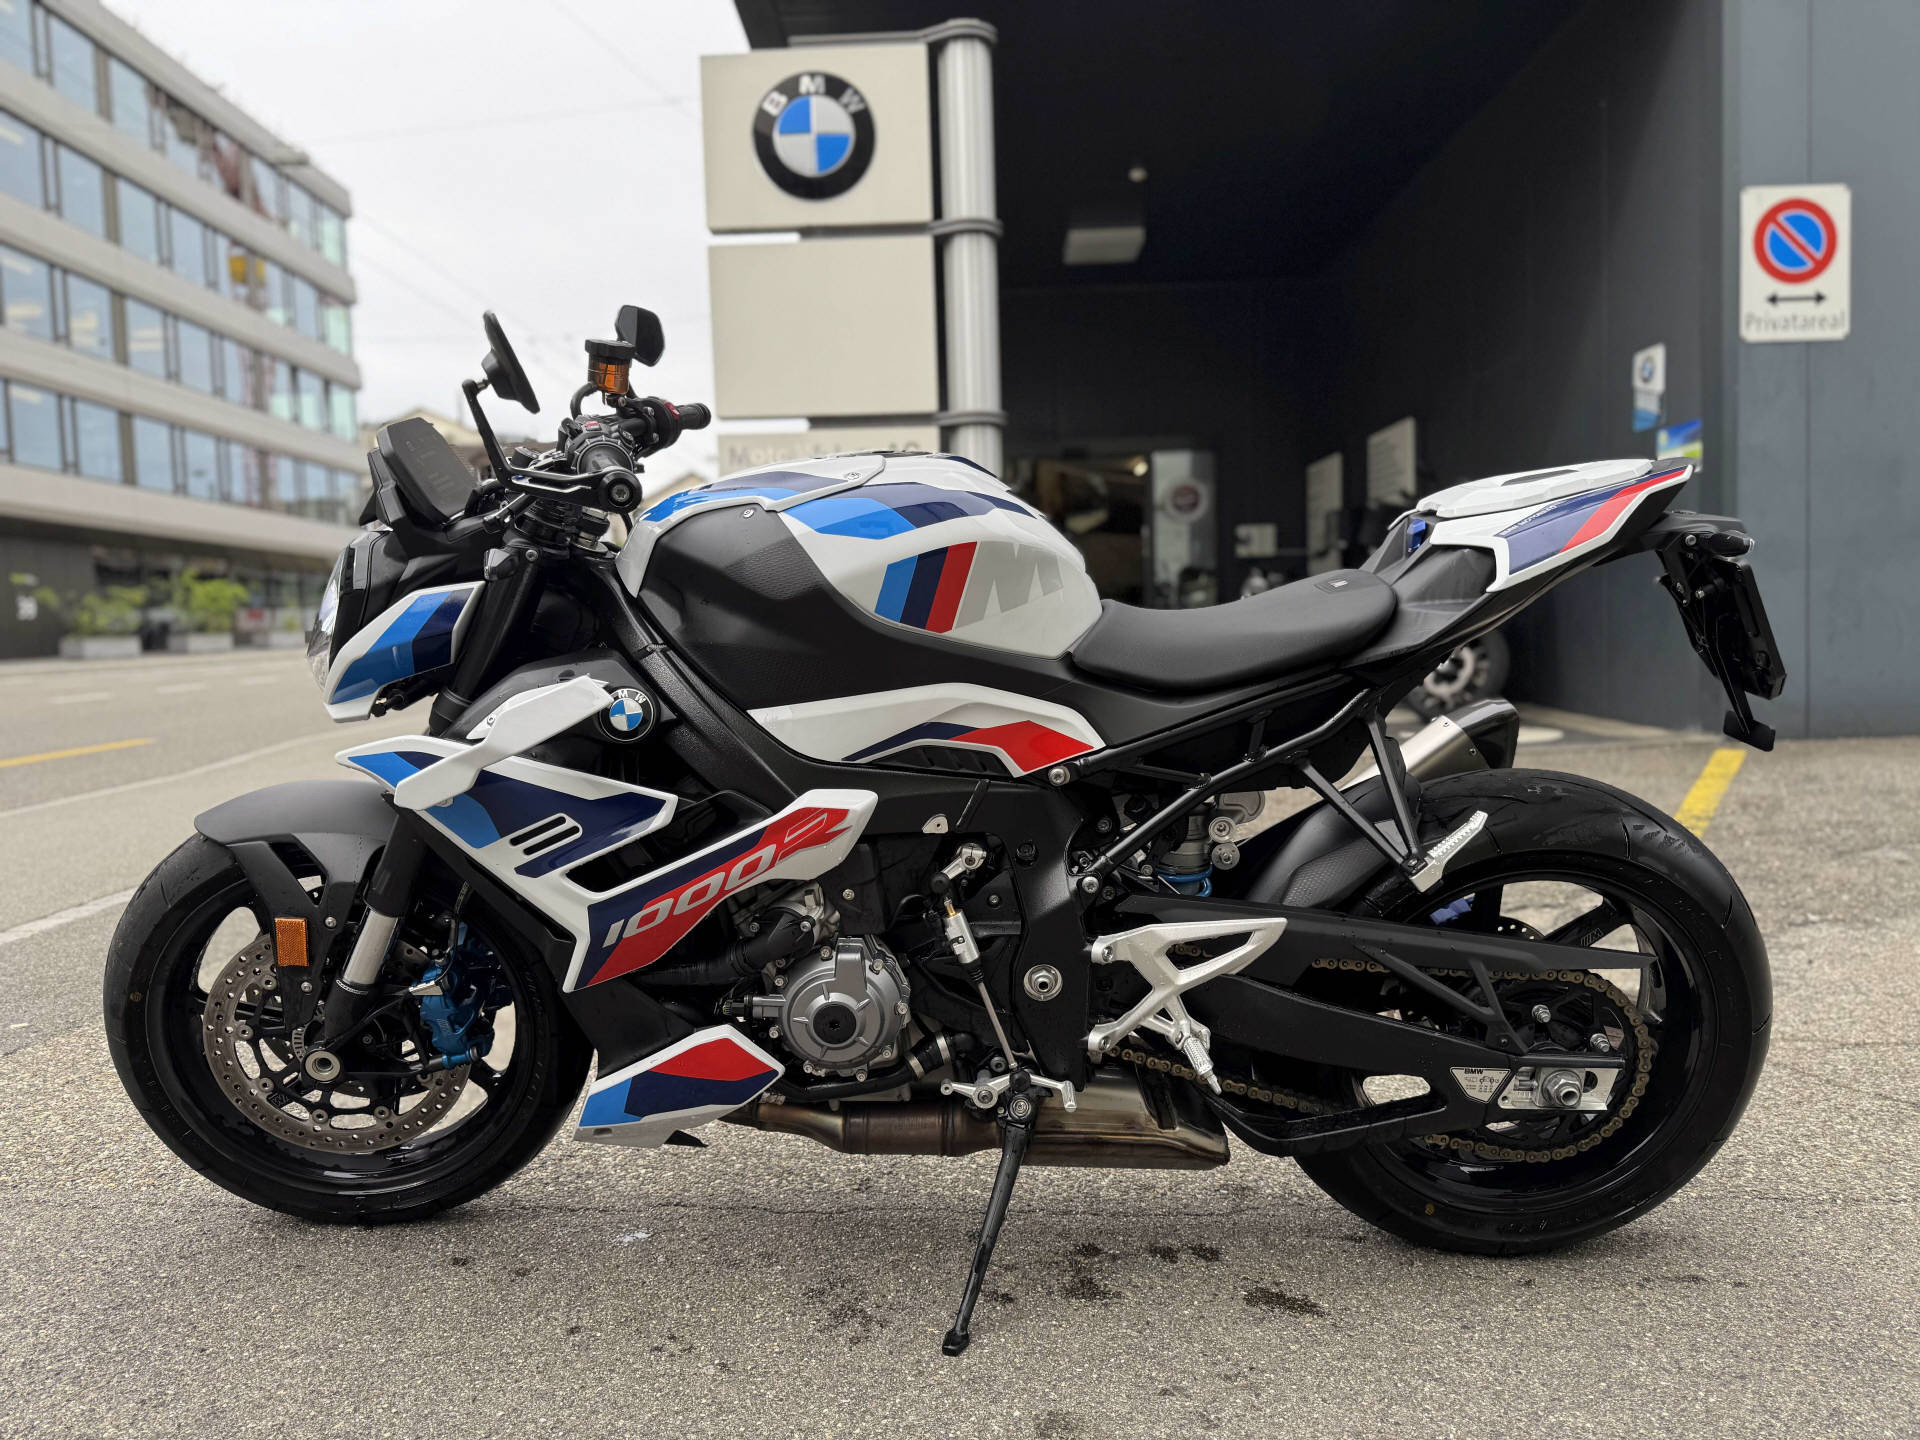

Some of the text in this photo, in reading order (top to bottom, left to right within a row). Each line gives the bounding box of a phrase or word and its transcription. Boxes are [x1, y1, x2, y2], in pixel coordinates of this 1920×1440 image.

[762, 74, 866, 117] BMW
[1745, 309, 1846, 332] Privatareal
[1464, 1067, 1484, 1075] BMW
